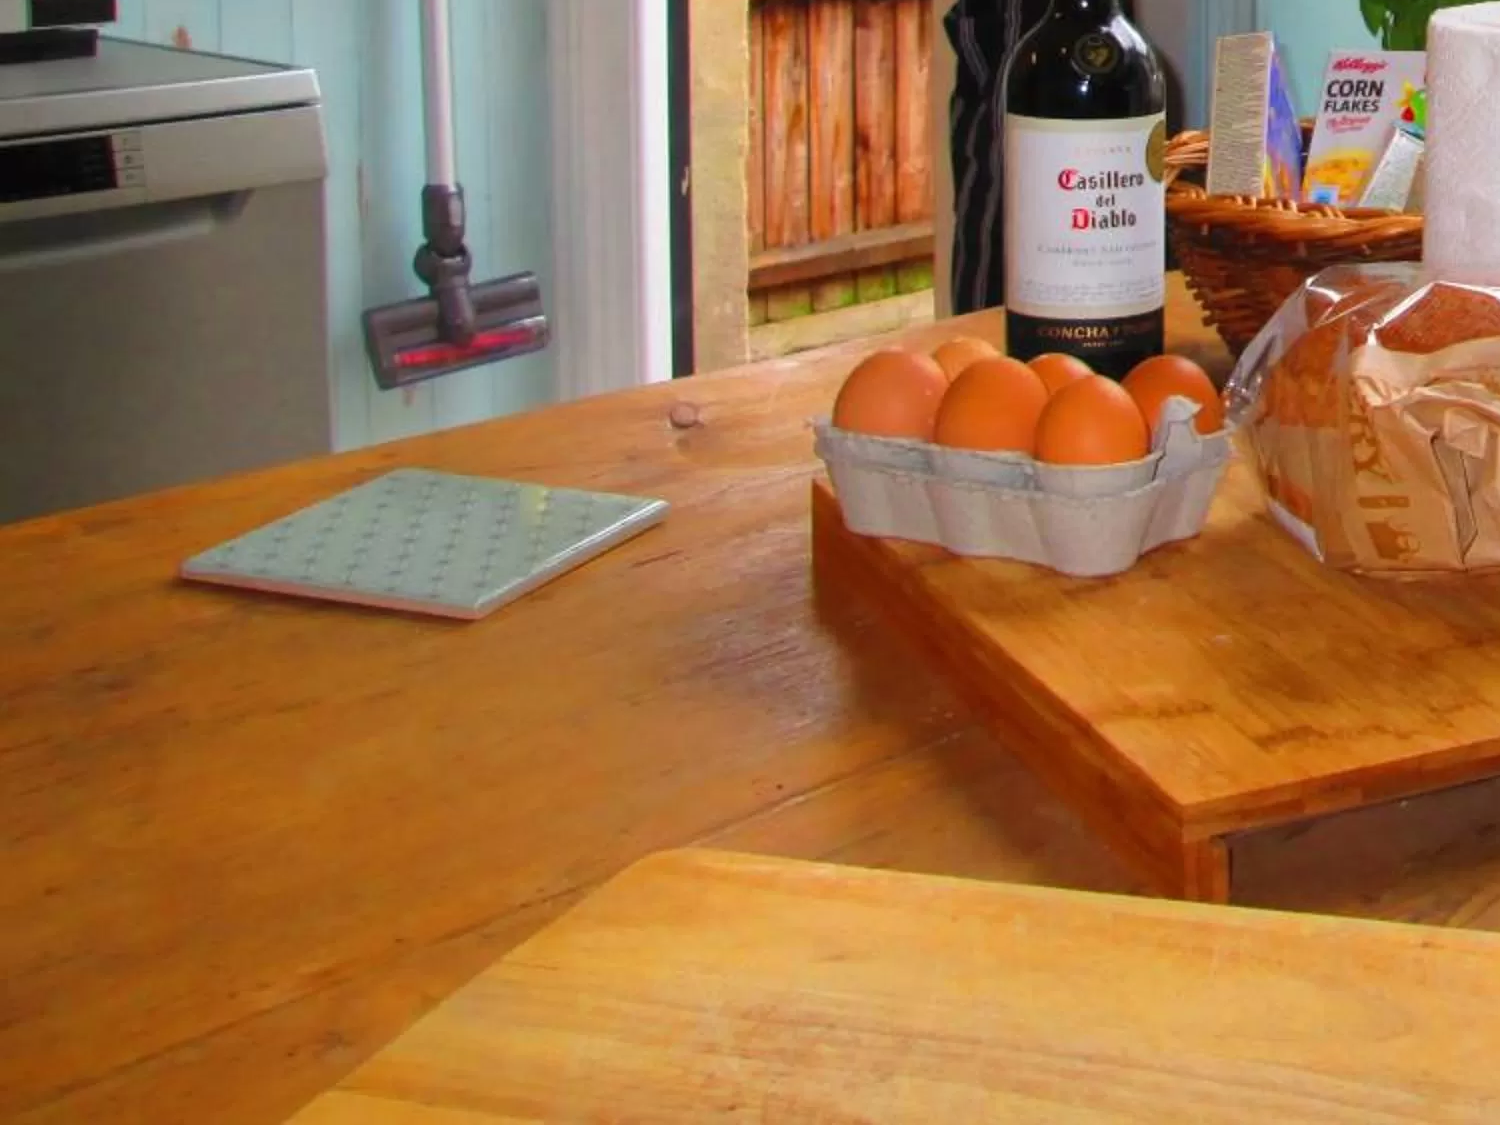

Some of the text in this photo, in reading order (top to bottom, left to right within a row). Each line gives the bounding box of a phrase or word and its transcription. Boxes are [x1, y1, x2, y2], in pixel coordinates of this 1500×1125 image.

[1326, 79, 1385, 98] CORN
[1323, 99, 1380, 113] FLAKES
[1058, 169, 1144, 190] Casillero
[1095, 194, 1115, 207] del
[1071, 208, 1137, 229] Diablo
